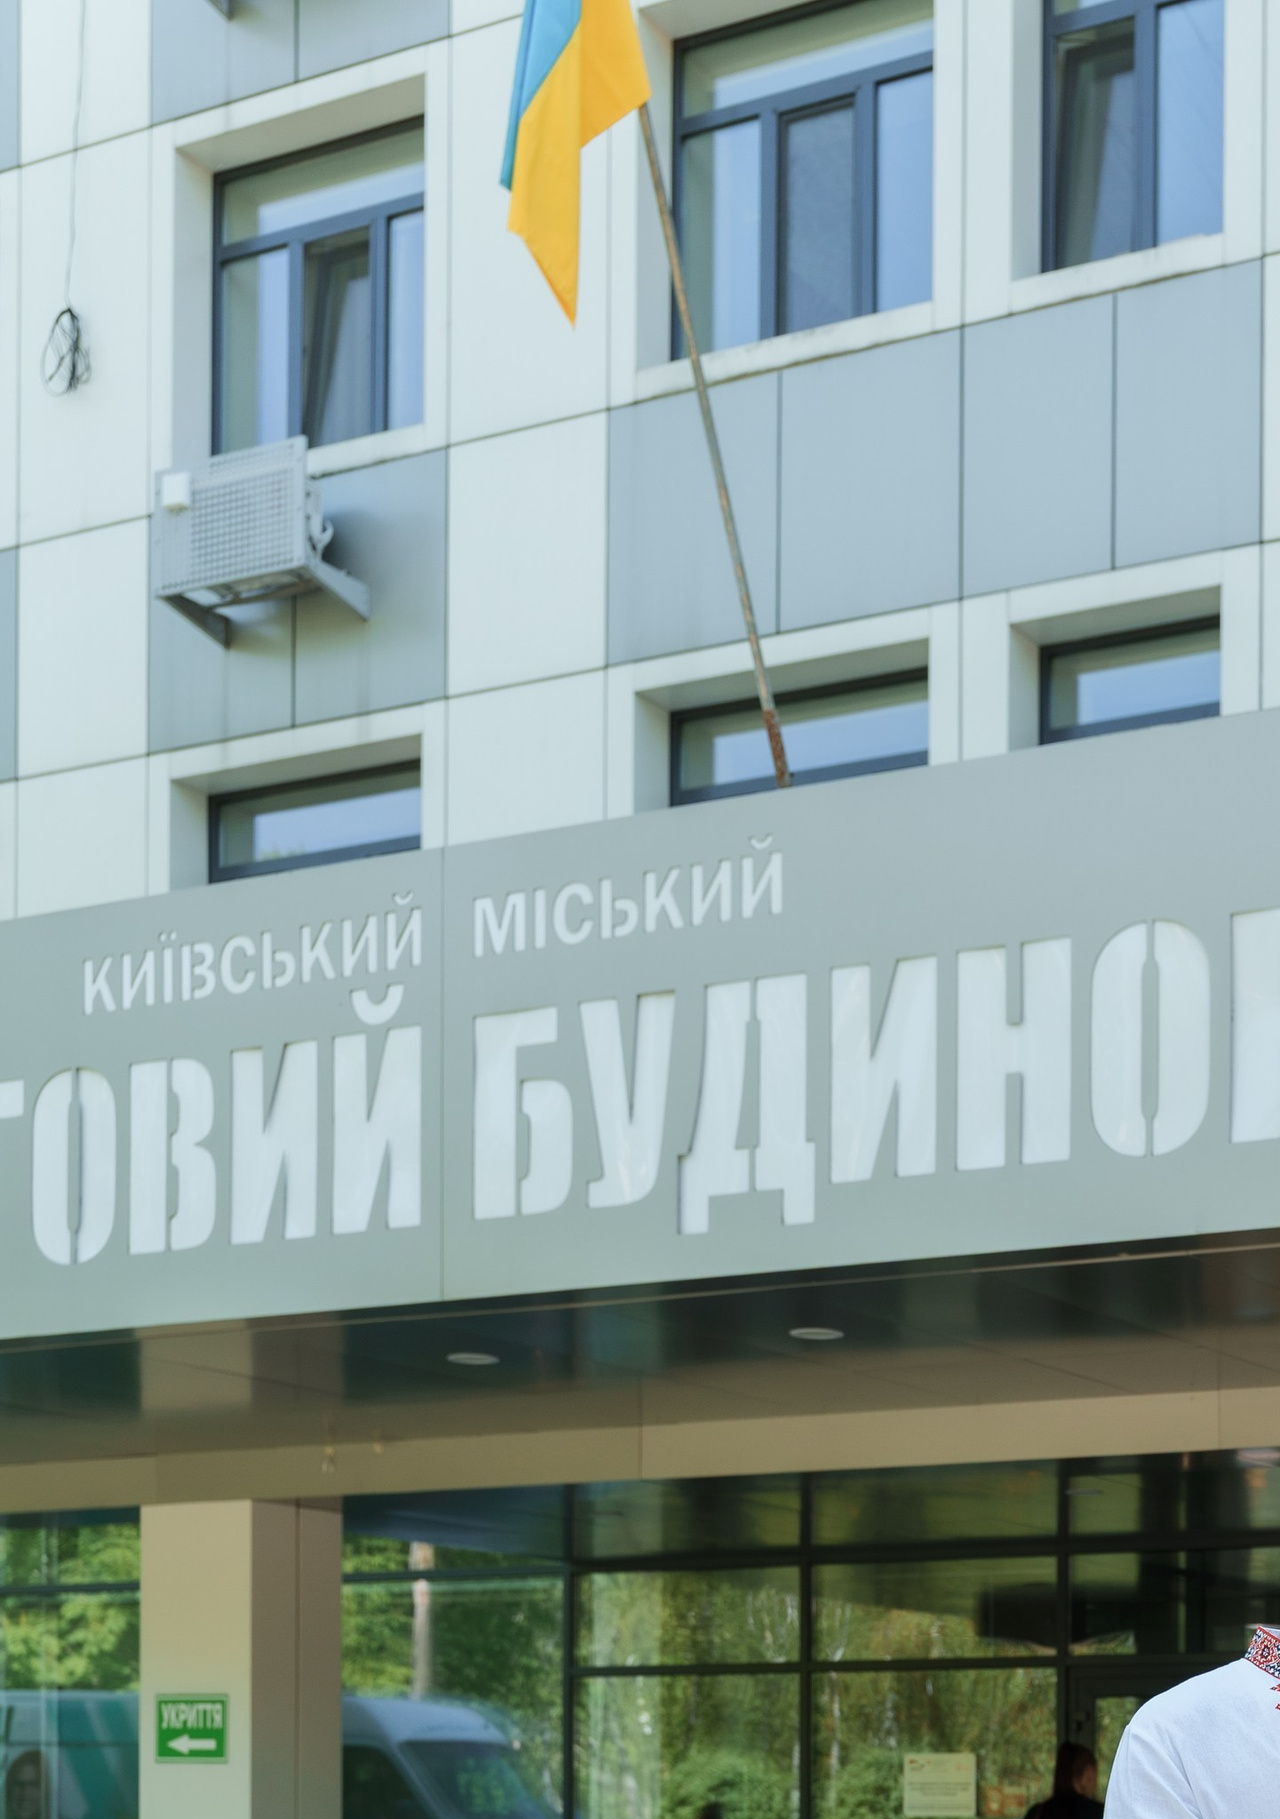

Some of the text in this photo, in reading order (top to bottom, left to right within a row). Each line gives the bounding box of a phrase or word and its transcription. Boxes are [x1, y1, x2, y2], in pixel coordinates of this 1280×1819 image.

[83, 834, 784, 1016] КИЇВСЬКИЙ МІСЬКИЙ
[161, 1702, 223, 1730] УКРИТТЯ
